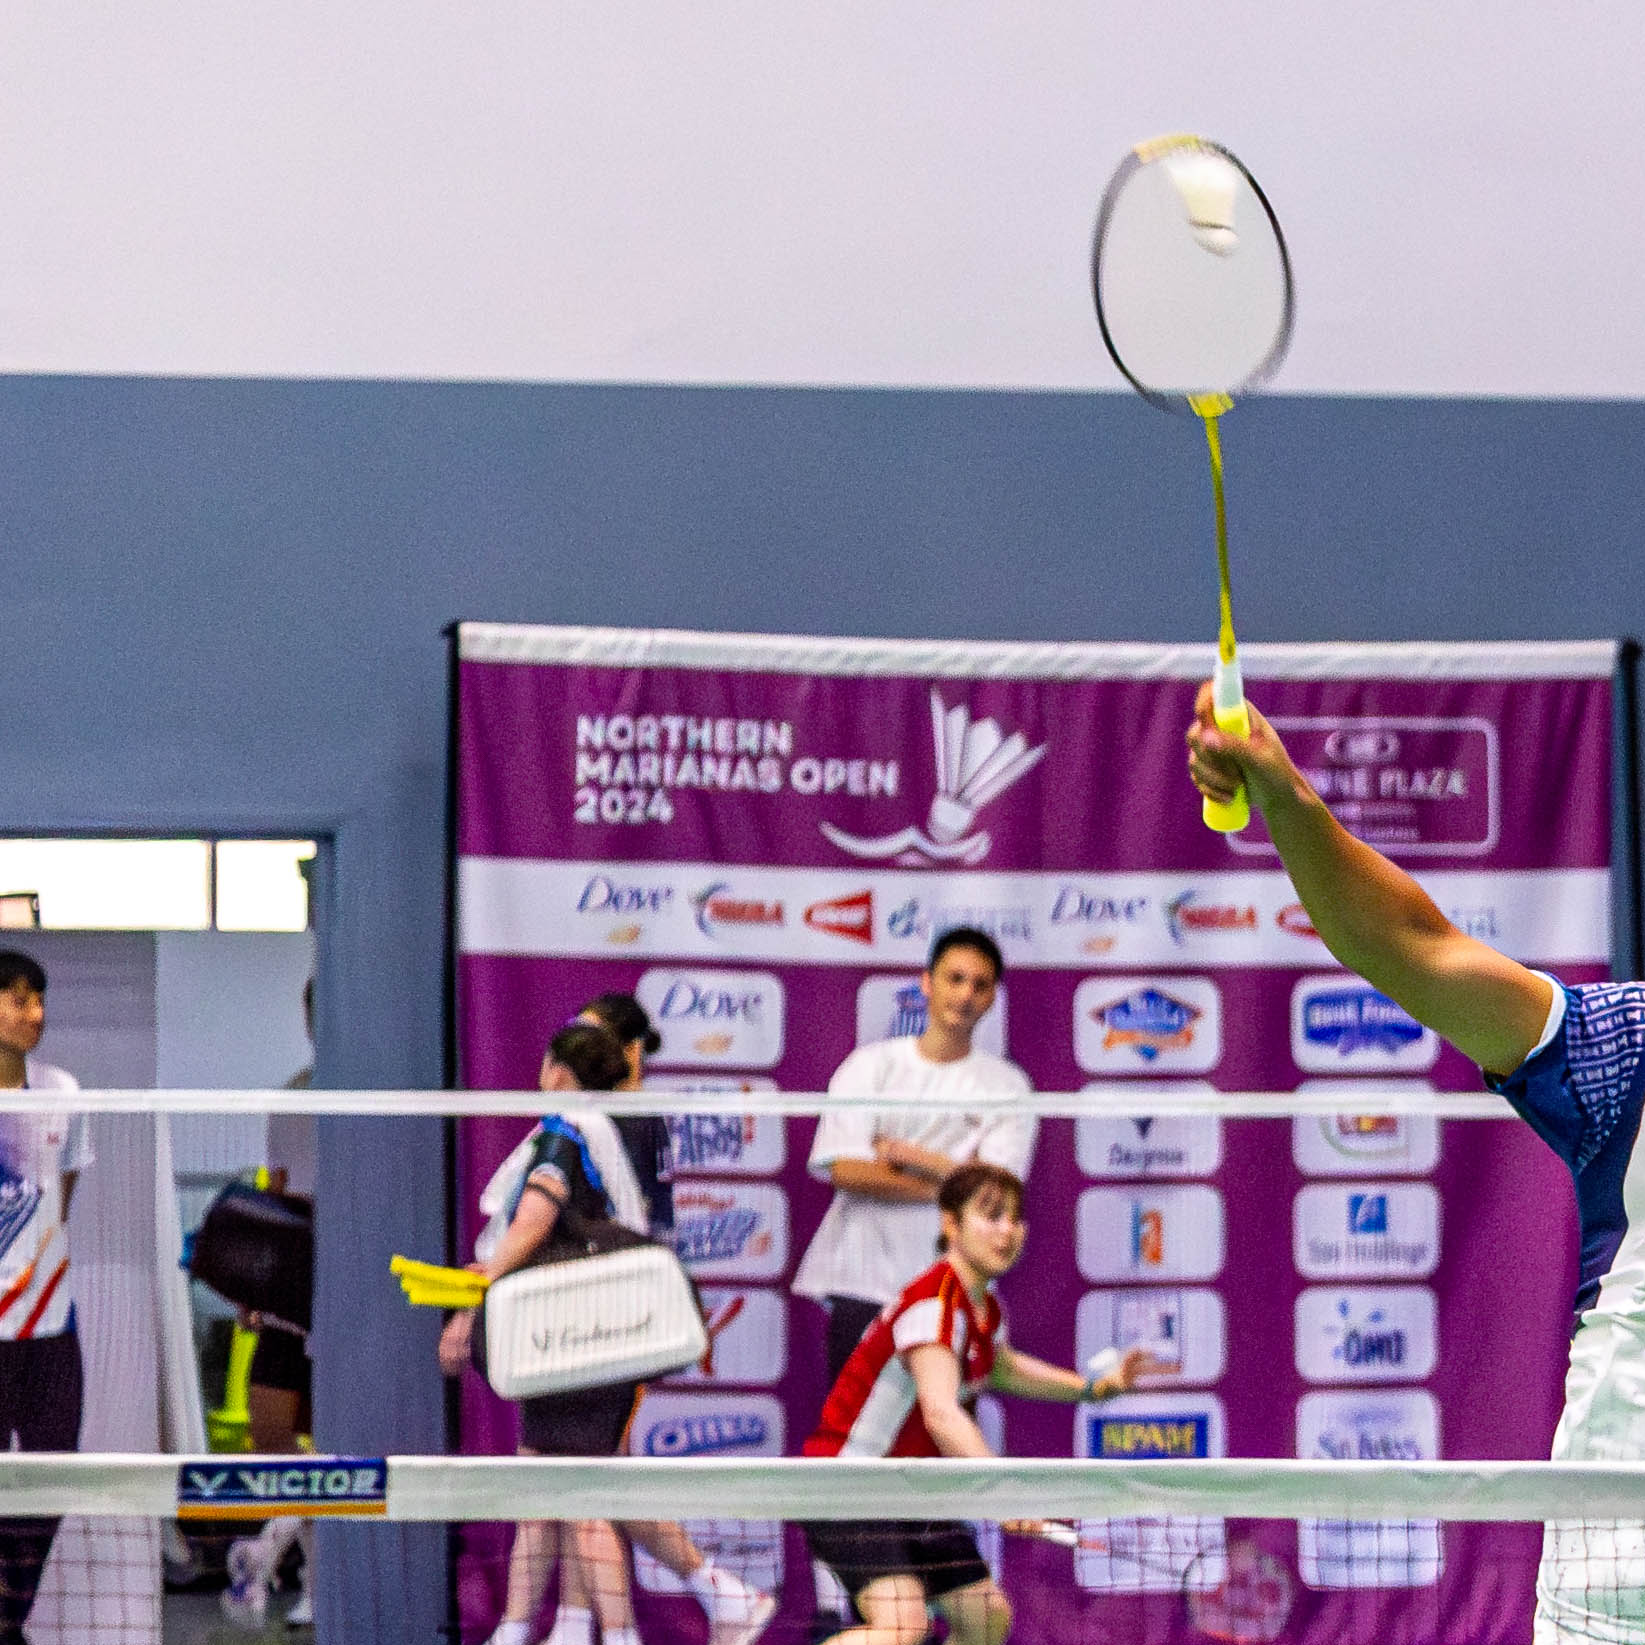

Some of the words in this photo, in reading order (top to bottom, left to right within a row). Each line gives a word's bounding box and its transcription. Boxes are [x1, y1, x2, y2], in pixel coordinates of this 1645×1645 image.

[576, 714, 794, 755] NORTHERN
[575, 752, 782, 792] MARIANAS
[790, 757, 900, 796] OPEN
[573, 788, 674, 825] 2024
[576, 875, 674, 913] Dove
[658, 980, 762, 1022] Dove
[239, 1466, 383, 1497] VICTOR
